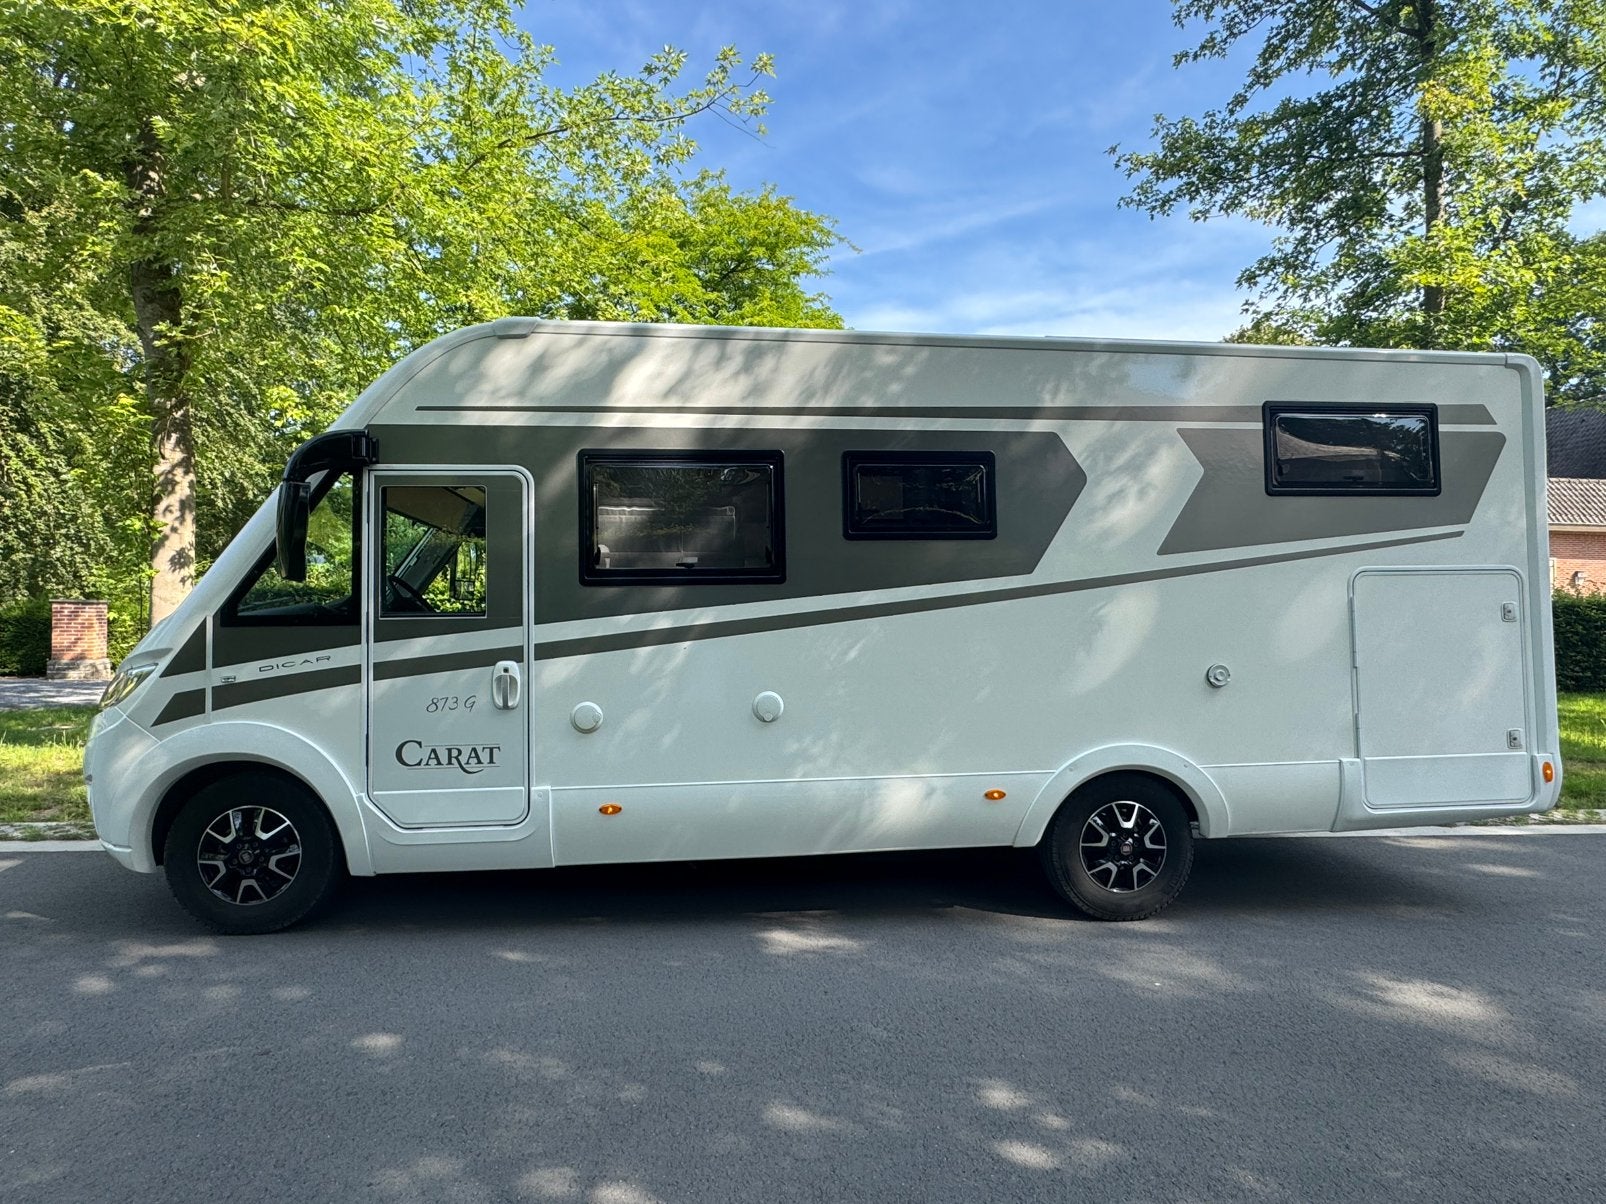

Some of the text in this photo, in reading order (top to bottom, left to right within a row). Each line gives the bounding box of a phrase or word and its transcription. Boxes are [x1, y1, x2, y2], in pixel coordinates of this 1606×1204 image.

[258, 655, 332, 673] DICAR
[426, 695, 477, 713] 873 G
[395, 740, 501, 774] CARAT
